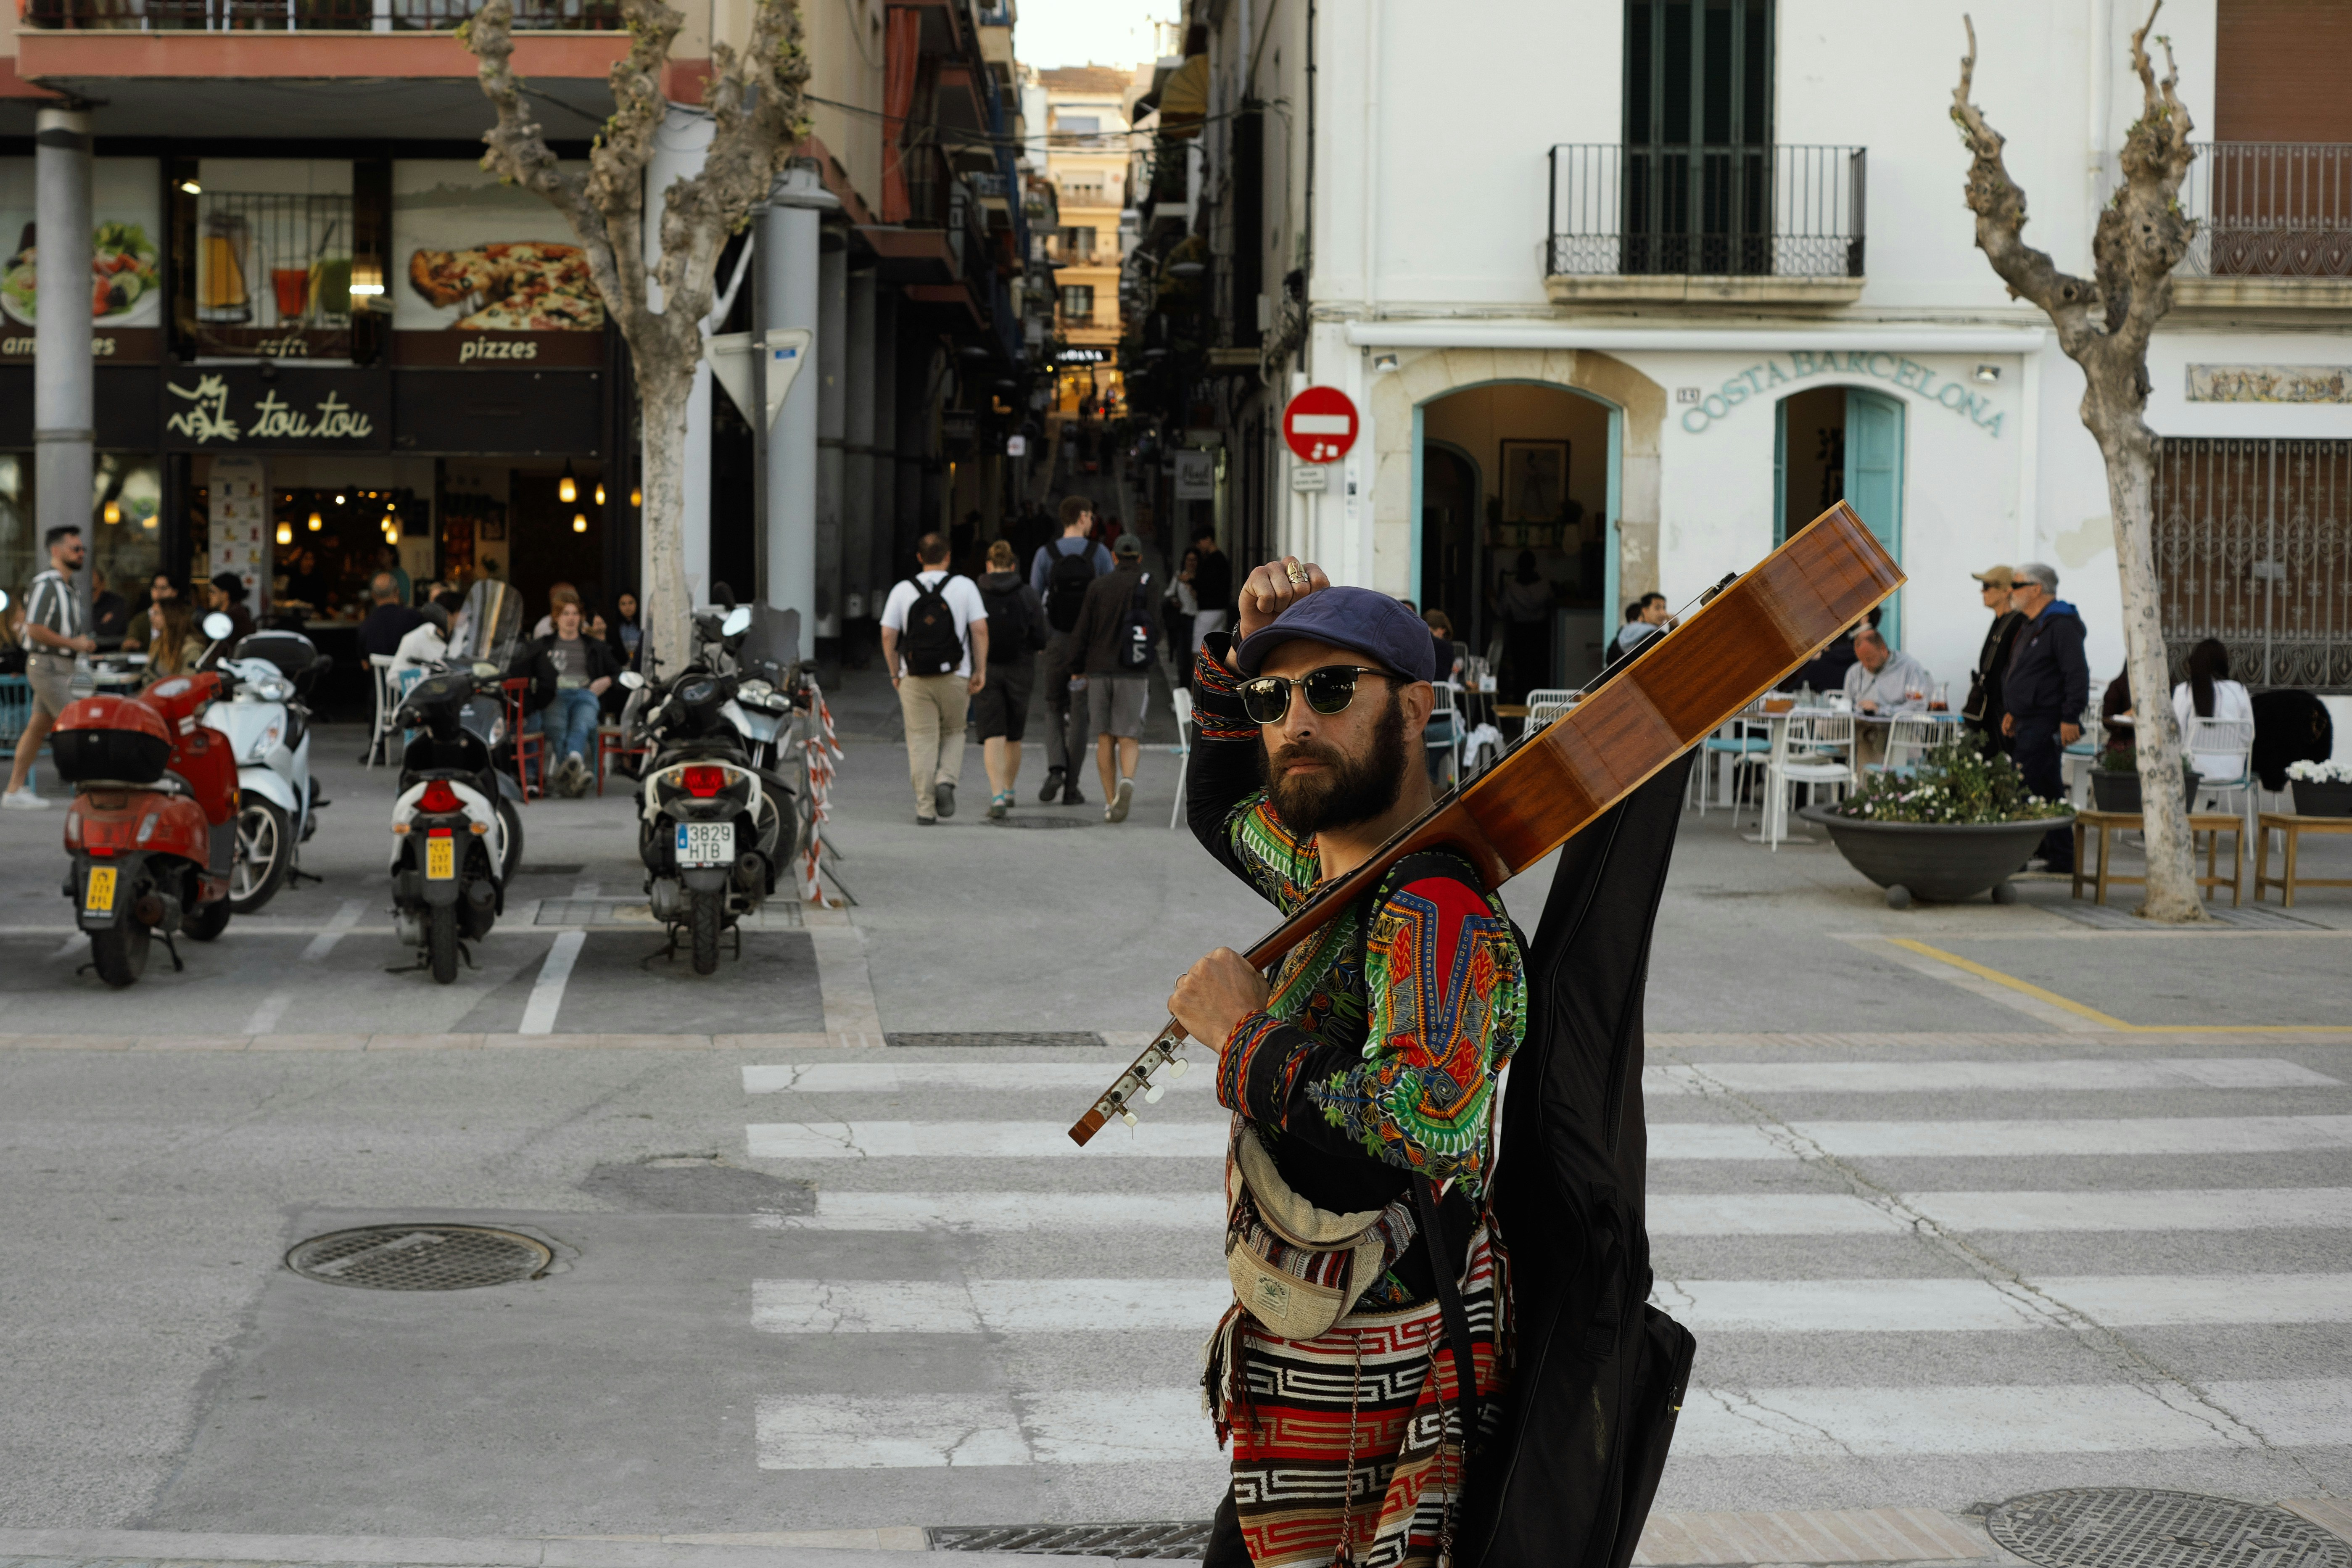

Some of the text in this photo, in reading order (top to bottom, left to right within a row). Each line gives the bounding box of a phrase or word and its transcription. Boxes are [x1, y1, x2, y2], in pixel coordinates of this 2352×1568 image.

[459, 336, 538, 364] pizzes
[1683, 349, 2005, 437] COSTA BARCELONA
[248, 390, 373, 438] tou tou
[1132, 625, 1147, 663] FILA
[690, 826, 730, 841] 3829
[689, 843, 720, 858] HTB
[1259, 1277, 1286, 1295] HIMALAYAN
